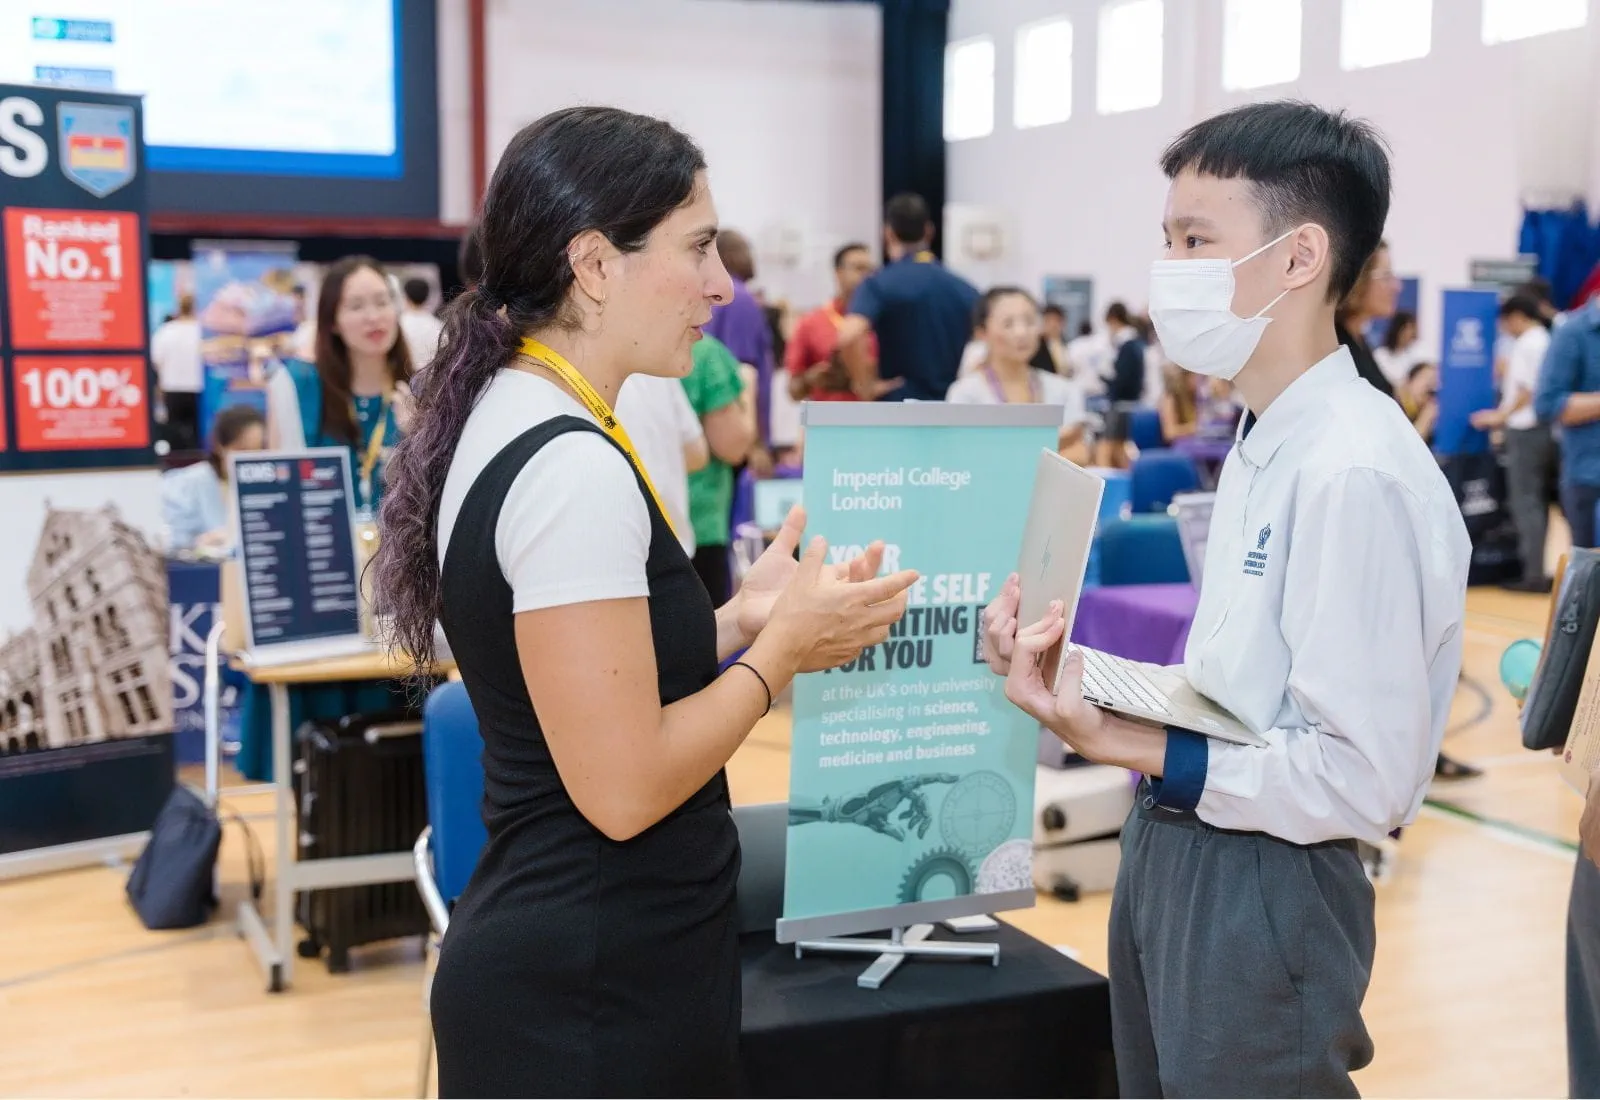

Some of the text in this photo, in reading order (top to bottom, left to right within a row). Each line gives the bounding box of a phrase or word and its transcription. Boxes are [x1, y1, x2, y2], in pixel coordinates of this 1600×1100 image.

[22, 215, 120, 243] Ranked
[25, 241, 123, 280] No.1
[21, 367, 142, 407] 100%
[832, 467, 972, 491] Imperial College
[832, 493, 902, 511] London
[829, 543, 901, 573] YOR
[932, 573, 991, 605] SELF
[882, 639, 934, 671] YOU
[821, 676, 997, 702] at the UK's only university
[821, 699, 978, 726] specialising in science,
[820, 720, 990, 747] technology, engineering,
[819, 742, 976, 768] medicine and business
